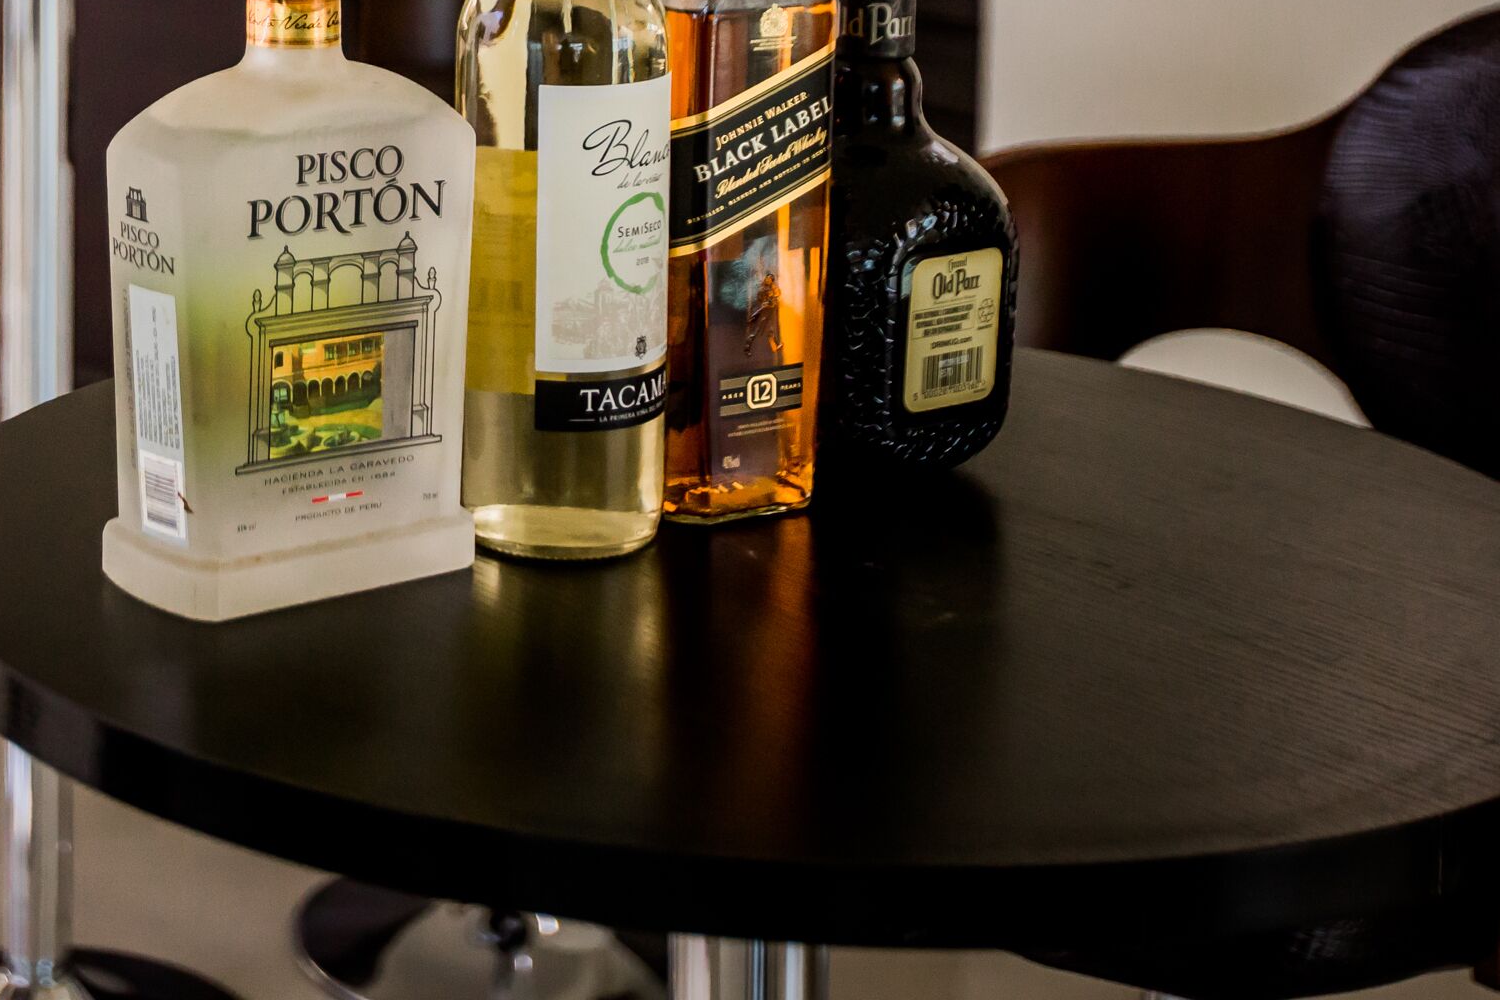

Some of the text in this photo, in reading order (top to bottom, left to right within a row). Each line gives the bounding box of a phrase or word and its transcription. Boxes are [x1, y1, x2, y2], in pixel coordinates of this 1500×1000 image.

[841, 5, 864, 38] ld
[715, 91, 809, 151] JOHNNIE WALKER
[693, 96, 833, 183] BLACK LABEL
[296, 145, 405, 187] PISCO
[714, 158, 763, 199] Blended
[786, 126, 828, 158] Whisky
[247, 177, 446, 239] PORTÓN
[120, 221, 160, 250] PISCO
[932, 267, 981, 300] Old Parr
[752, 381, 772, 402] 12
[264, 454, 416, 487] HACIENDA LA CARAVEDO
[295, 509, 341, 521] PRODUCTO
[344, 506, 356, 514] DE
